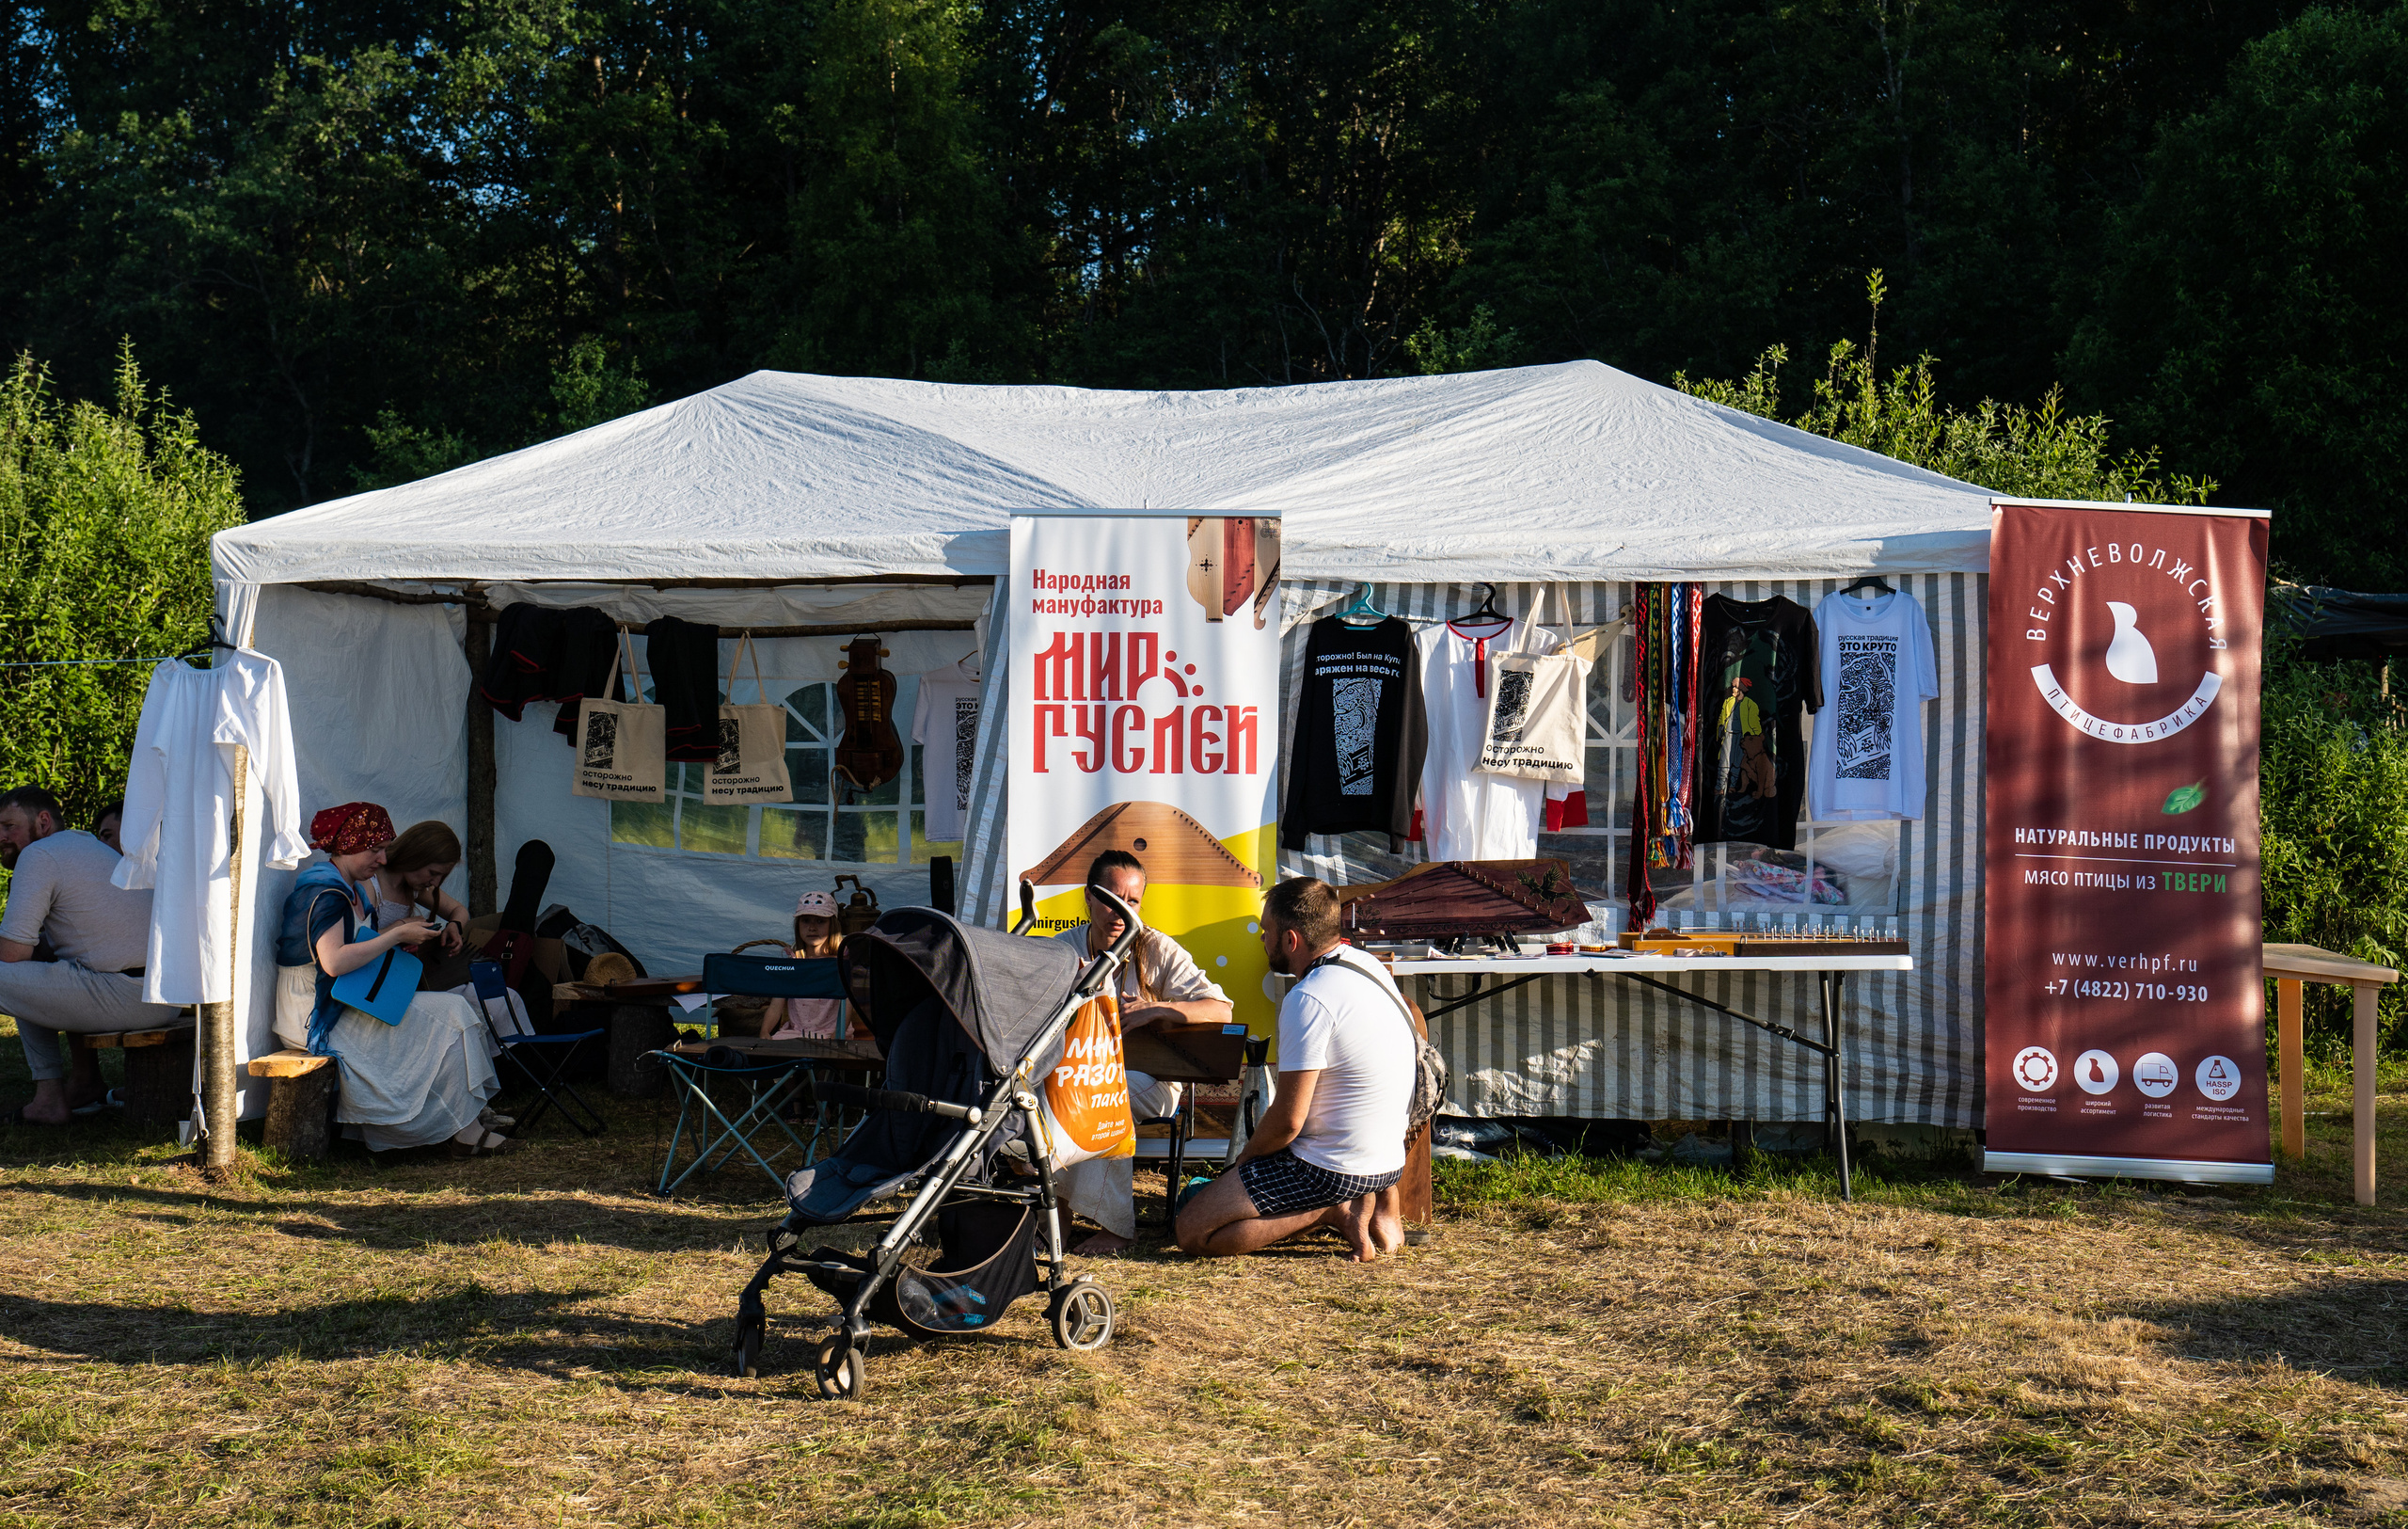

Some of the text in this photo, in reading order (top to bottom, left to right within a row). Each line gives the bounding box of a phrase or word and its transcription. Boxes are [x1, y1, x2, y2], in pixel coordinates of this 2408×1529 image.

[1032, 568, 1131, 594] Народная
[1033, 594, 1163, 618] мануфактура
[2026, 543, 2227, 650] ВЕРХНЕВОЛЖСКАЯ
[1316, 652, 1354, 662] торожно!
[1356, 651, 1371, 660] Был
[1839, 642, 1896, 652] ЭТО КРУТО
[1034, 631, 1159, 701] МИР
[1370, 665, 1390, 675] весь
[2047, 688, 2207, 741] ПТИЦЕФАБРИКА
[1034, 704, 1258, 775] ГУСЛЕЙ
[1482, 757, 1573, 770] несу традицию
[582, 770, 632, 781] осторожно
[582, 780, 657, 793] несу традицию
[712, 775, 760, 786] осторожно
[712, 784, 784, 795] несу традицию
[2015, 827, 2235, 854] НАТУРАЛЬНЫЕ ПРОДУКТЫ
[2024, 869, 2226, 893] МЯСО ПТИЦЫ ИЗ ТВЕРИ
[2052, 952, 2197, 974] www.verhpf.ru
[2044, 979, 2208, 1002] +7 (4822) 710-930
